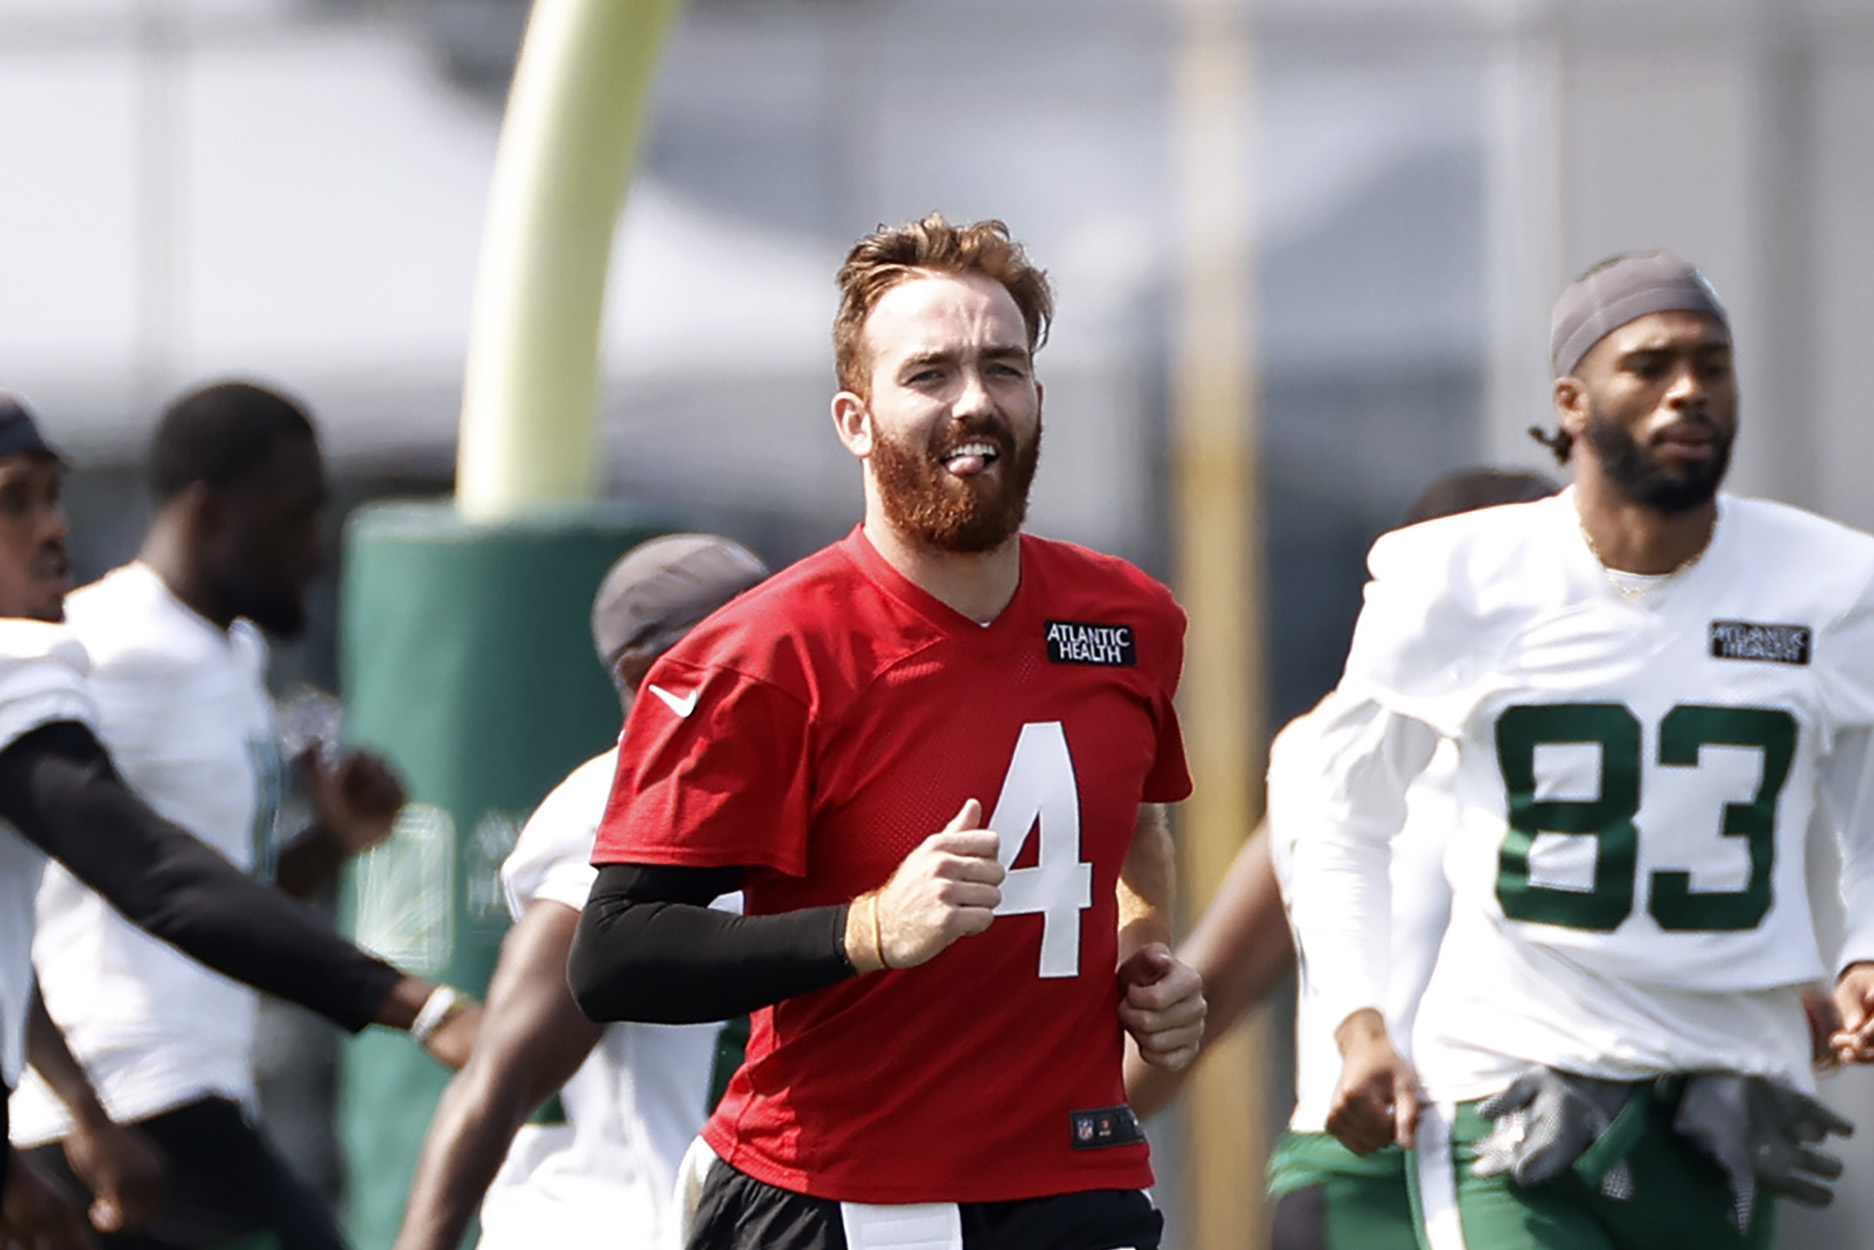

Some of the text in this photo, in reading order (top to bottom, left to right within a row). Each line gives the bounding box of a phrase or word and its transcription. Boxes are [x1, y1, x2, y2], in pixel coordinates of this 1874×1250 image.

[1047, 623, 1130, 647] ATLANTIC
[1060, 641, 1121, 663] HEALTH
[988, 721, 1093, 978] 4
[1495, 704, 1797, 934] 83
